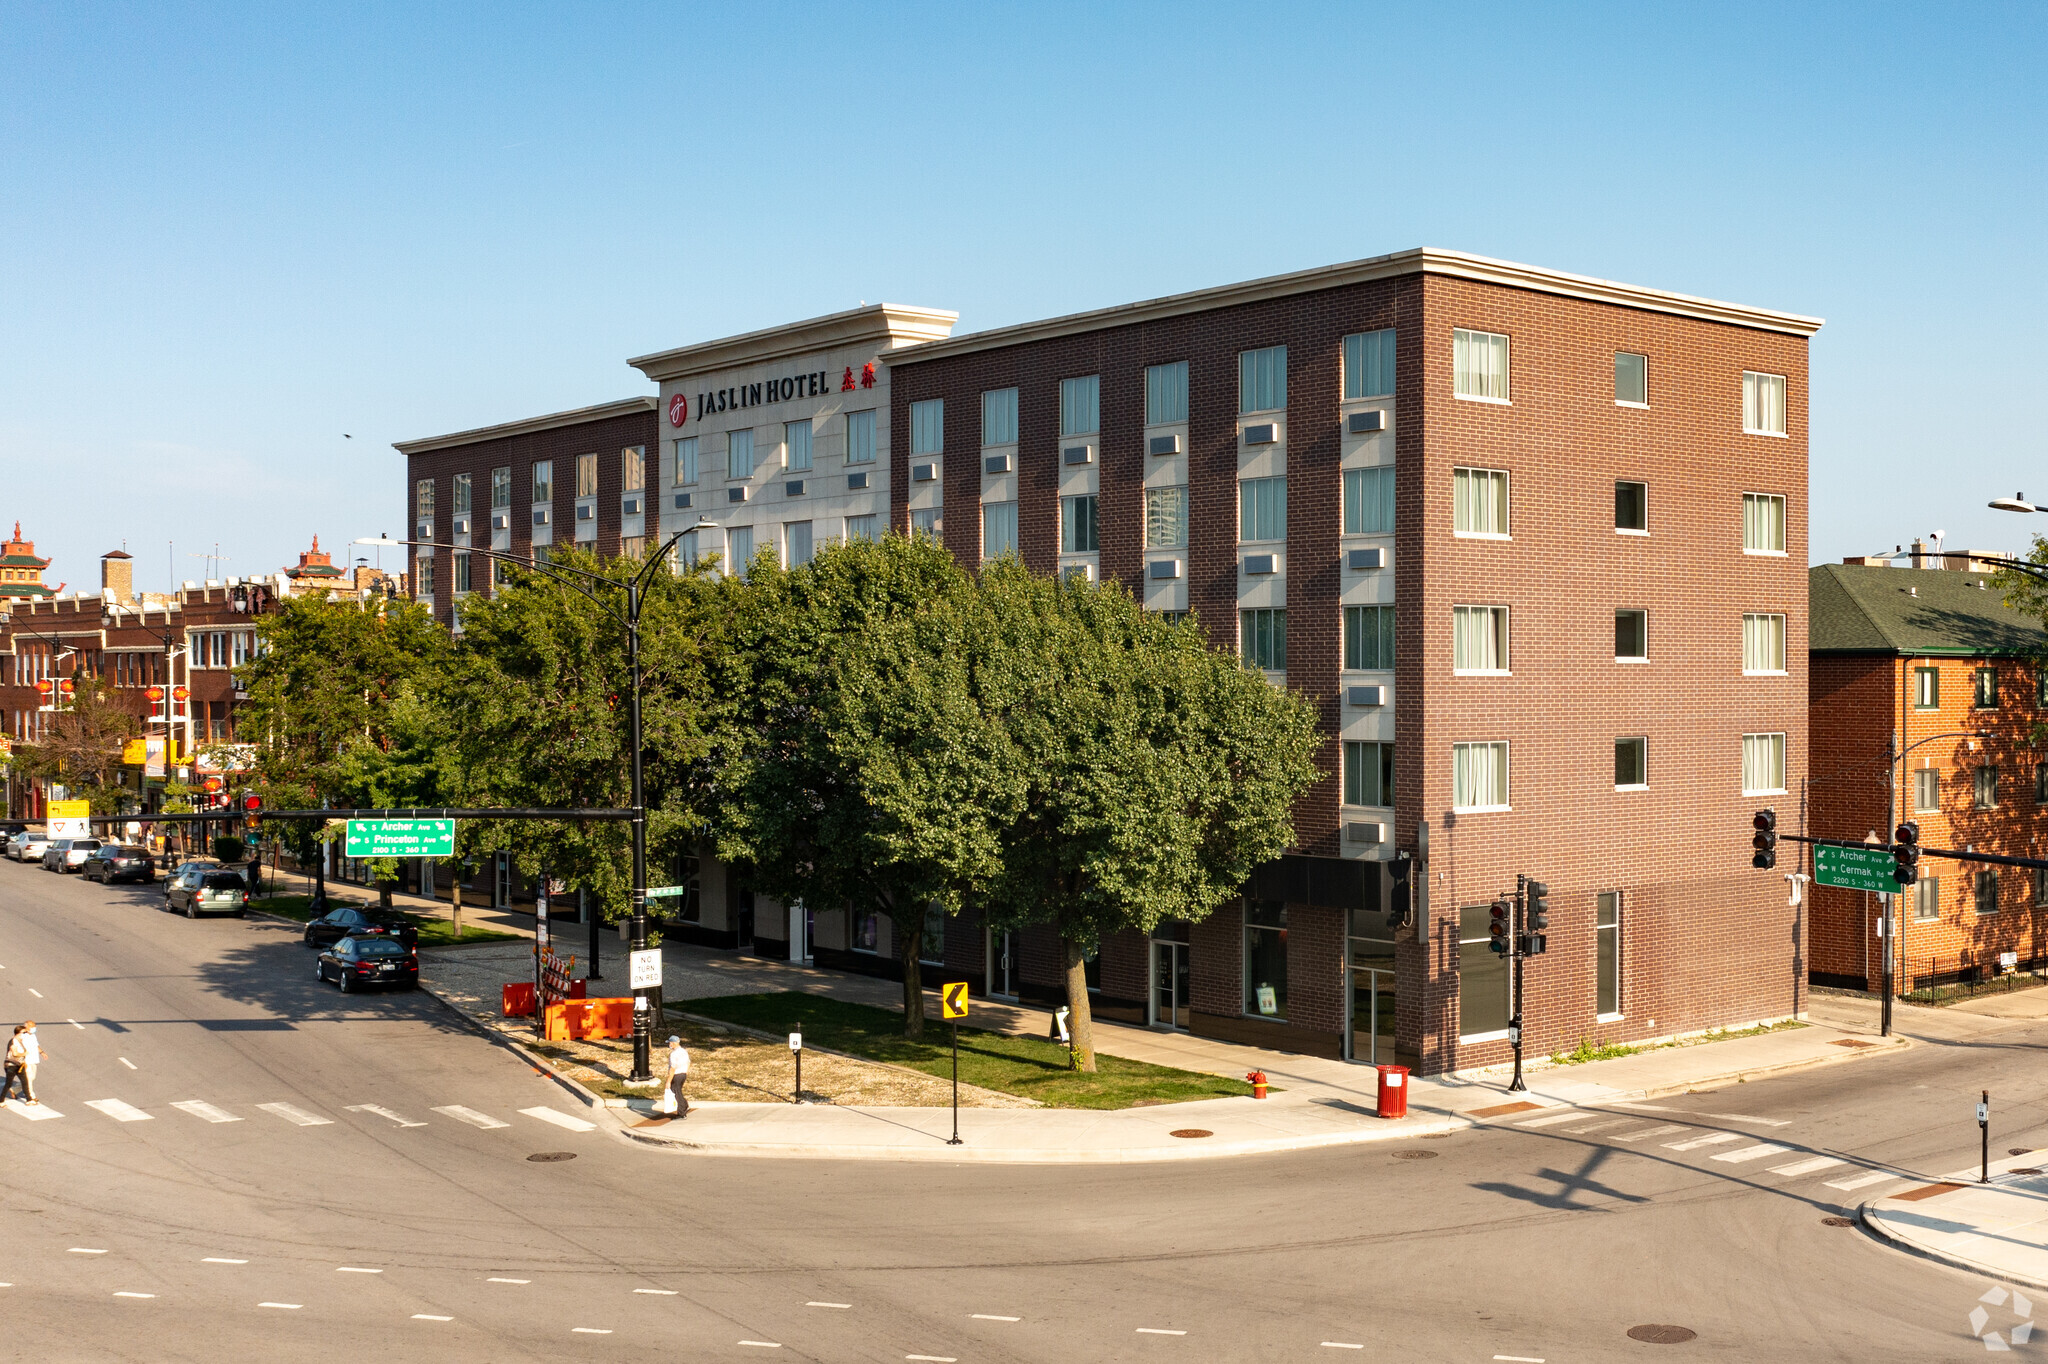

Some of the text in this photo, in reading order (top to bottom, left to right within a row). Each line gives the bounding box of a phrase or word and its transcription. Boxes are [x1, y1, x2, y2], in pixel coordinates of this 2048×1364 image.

[765, 371, 829, 403] HOTEL
[381, 822, 413, 831] Archer
[374, 834, 419, 844] Princeton
[372, 846, 389, 854] 2100
[1831, 850, 1882, 864] S Archer Ave
[1840, 864, 1872, 876] Cermak
[1876, 870, 1884, 878] Rd
[1833, 876, 1849, 884] 2200
[1863, 880, 1875, 888] 360
[1878, 881, 1883, 889] W
[646, 973, 659, 981] RED
